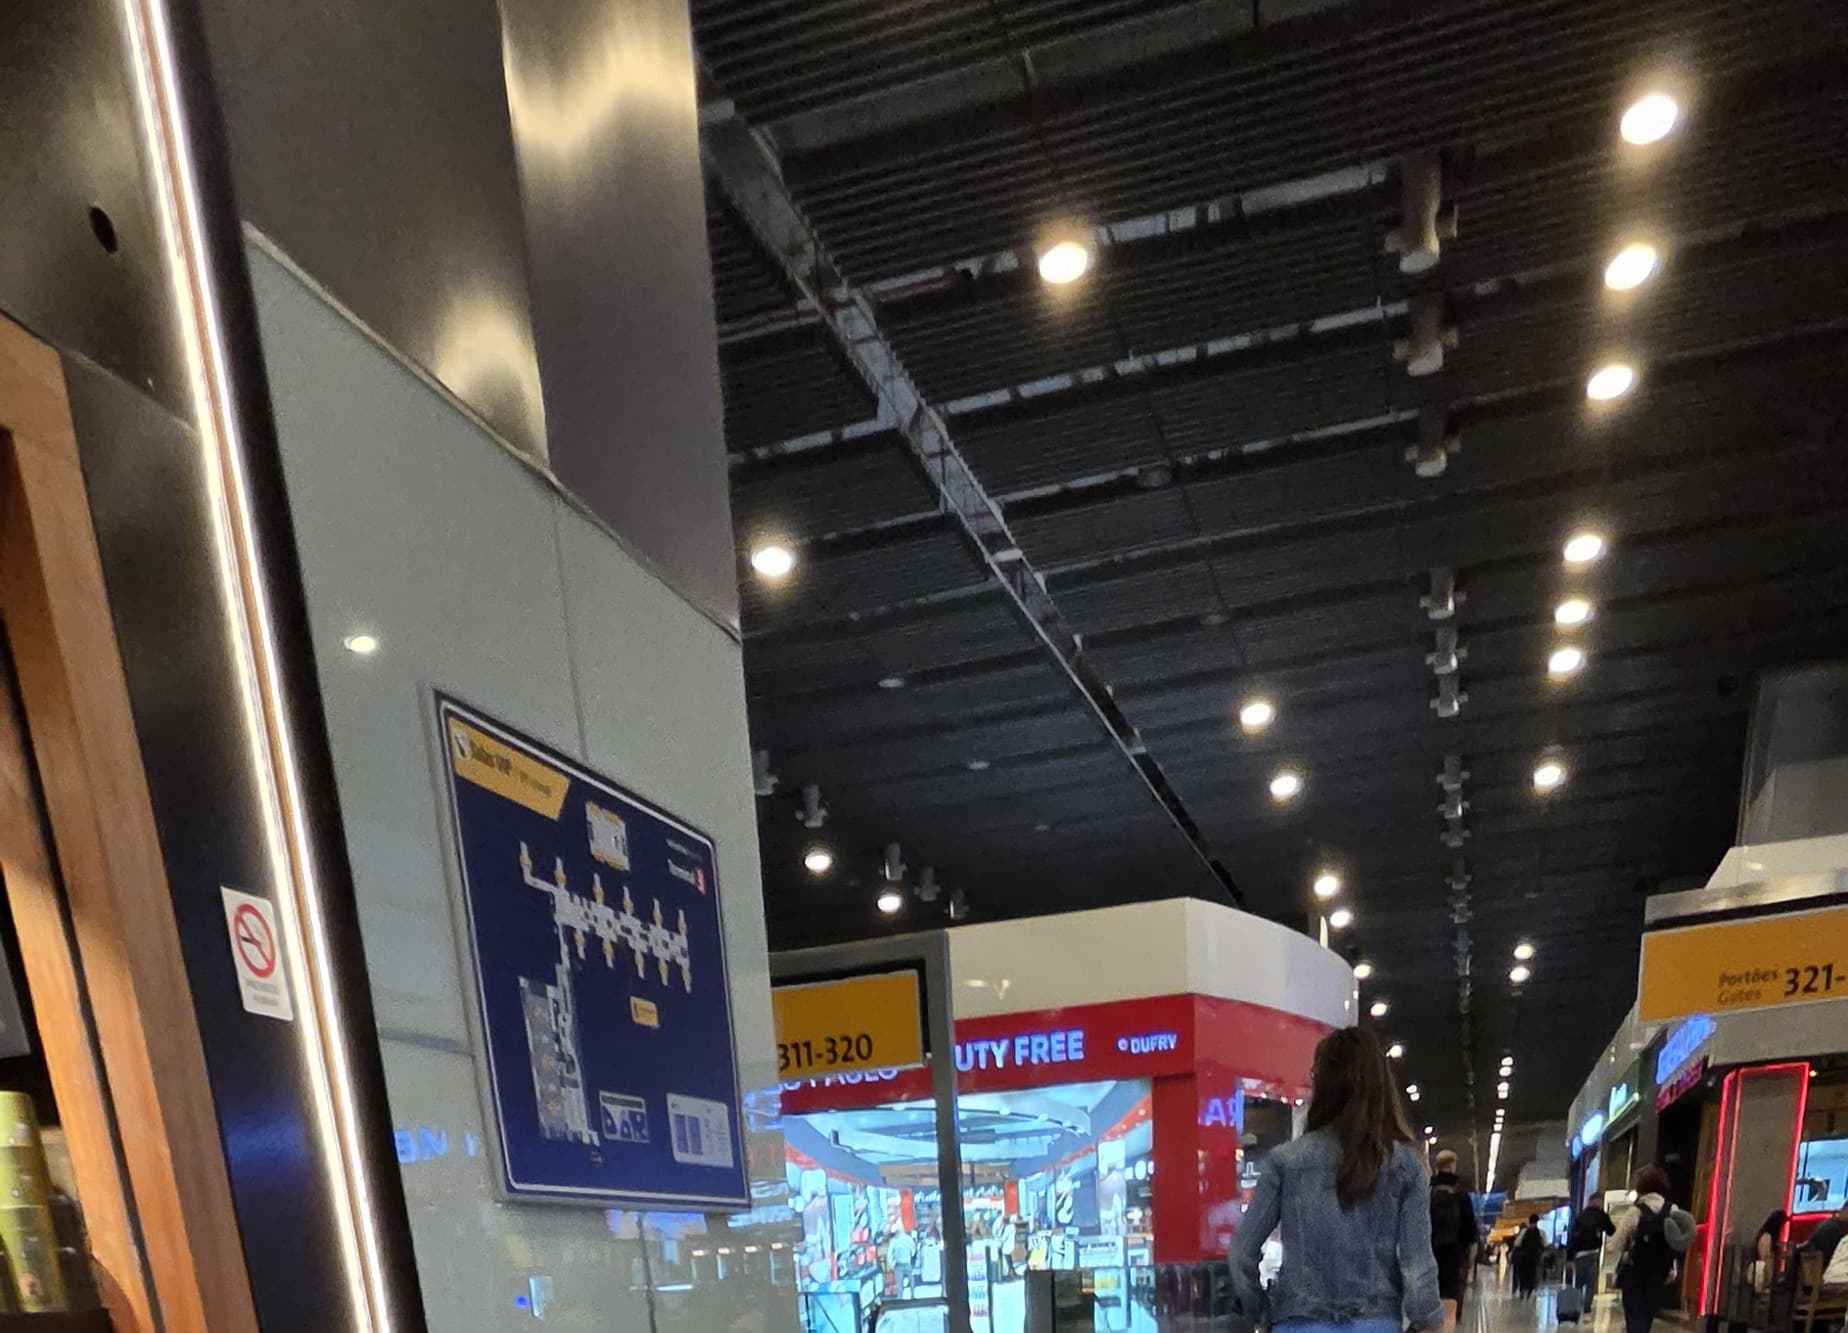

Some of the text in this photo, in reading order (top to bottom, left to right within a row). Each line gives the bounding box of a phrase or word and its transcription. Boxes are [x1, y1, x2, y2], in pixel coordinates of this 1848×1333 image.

[777, 1033, 874, 1071] 311-320
[953, 1039, 1009, 1072] UTY
[1013, 1029, 1085, 1066] FREE
[1129, 1032, 1178, 1054] DUFRY
